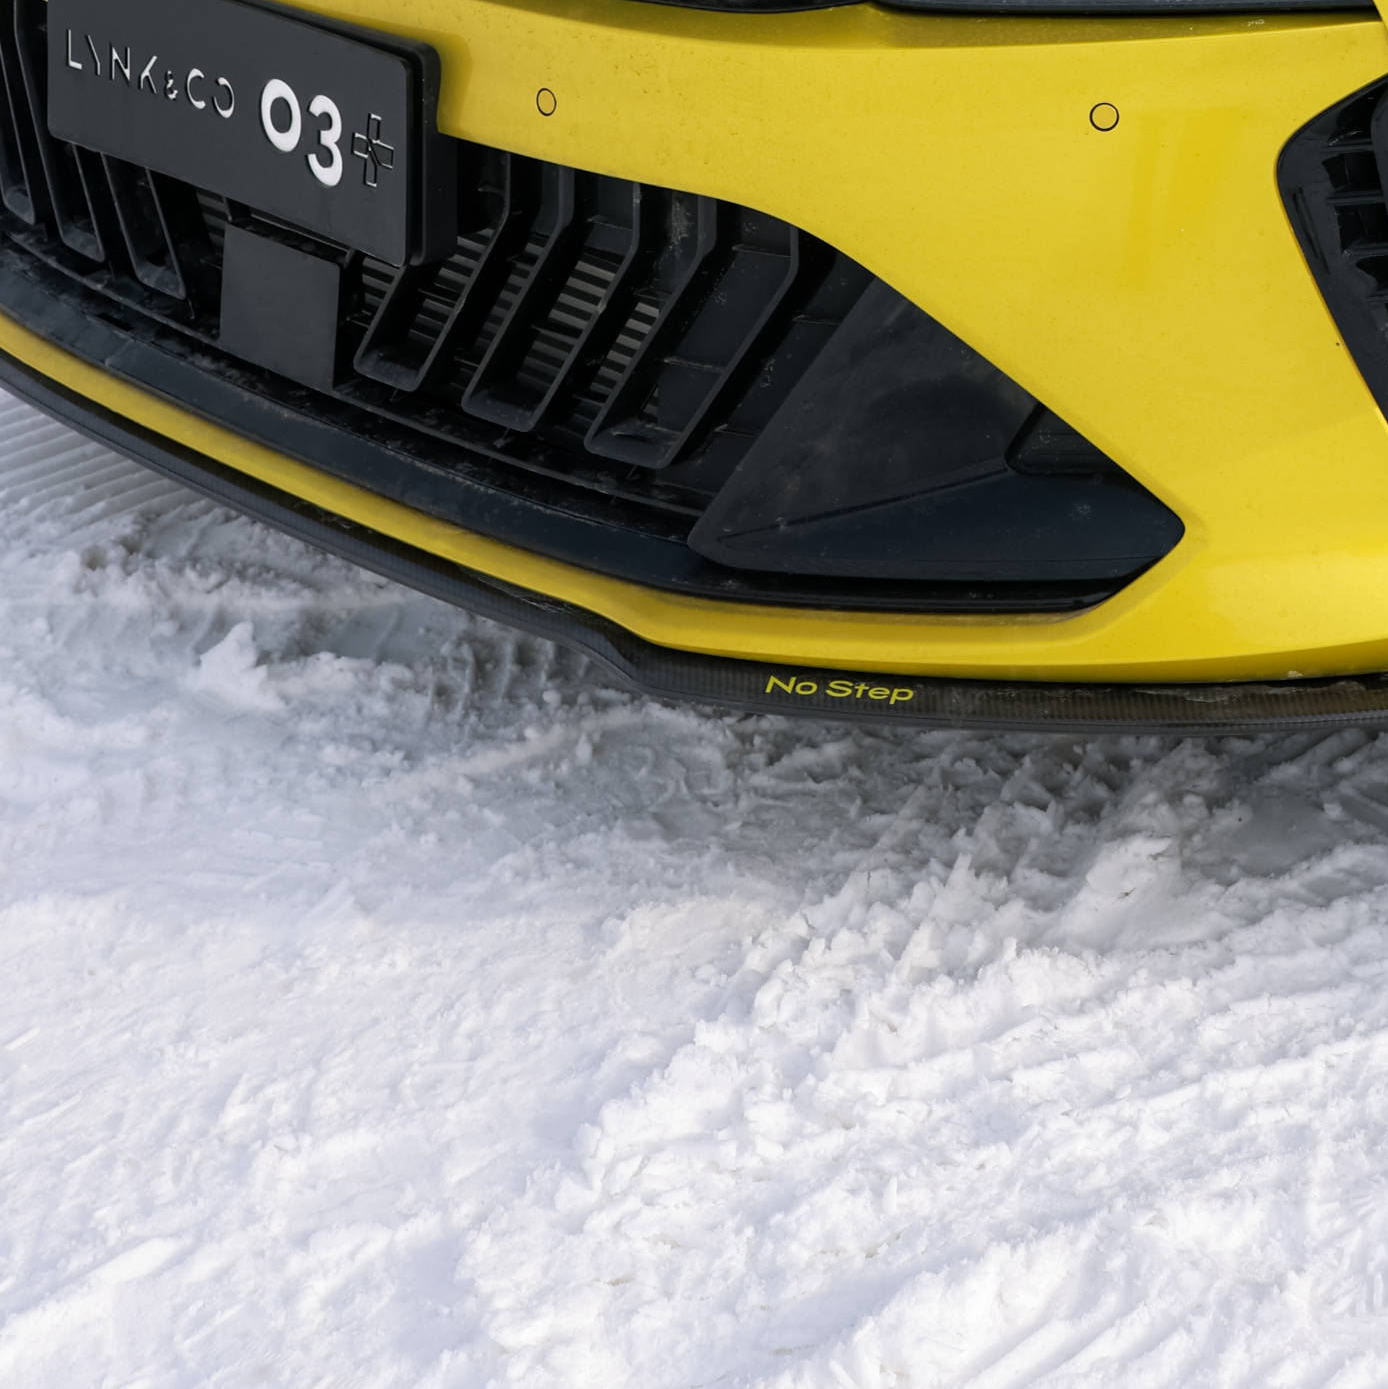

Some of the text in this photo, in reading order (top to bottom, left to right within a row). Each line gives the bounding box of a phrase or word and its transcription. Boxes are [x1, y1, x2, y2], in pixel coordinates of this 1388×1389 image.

[66, 29, 236, 119] LYNK&CO
[765, 675, 914, 705] No Step
